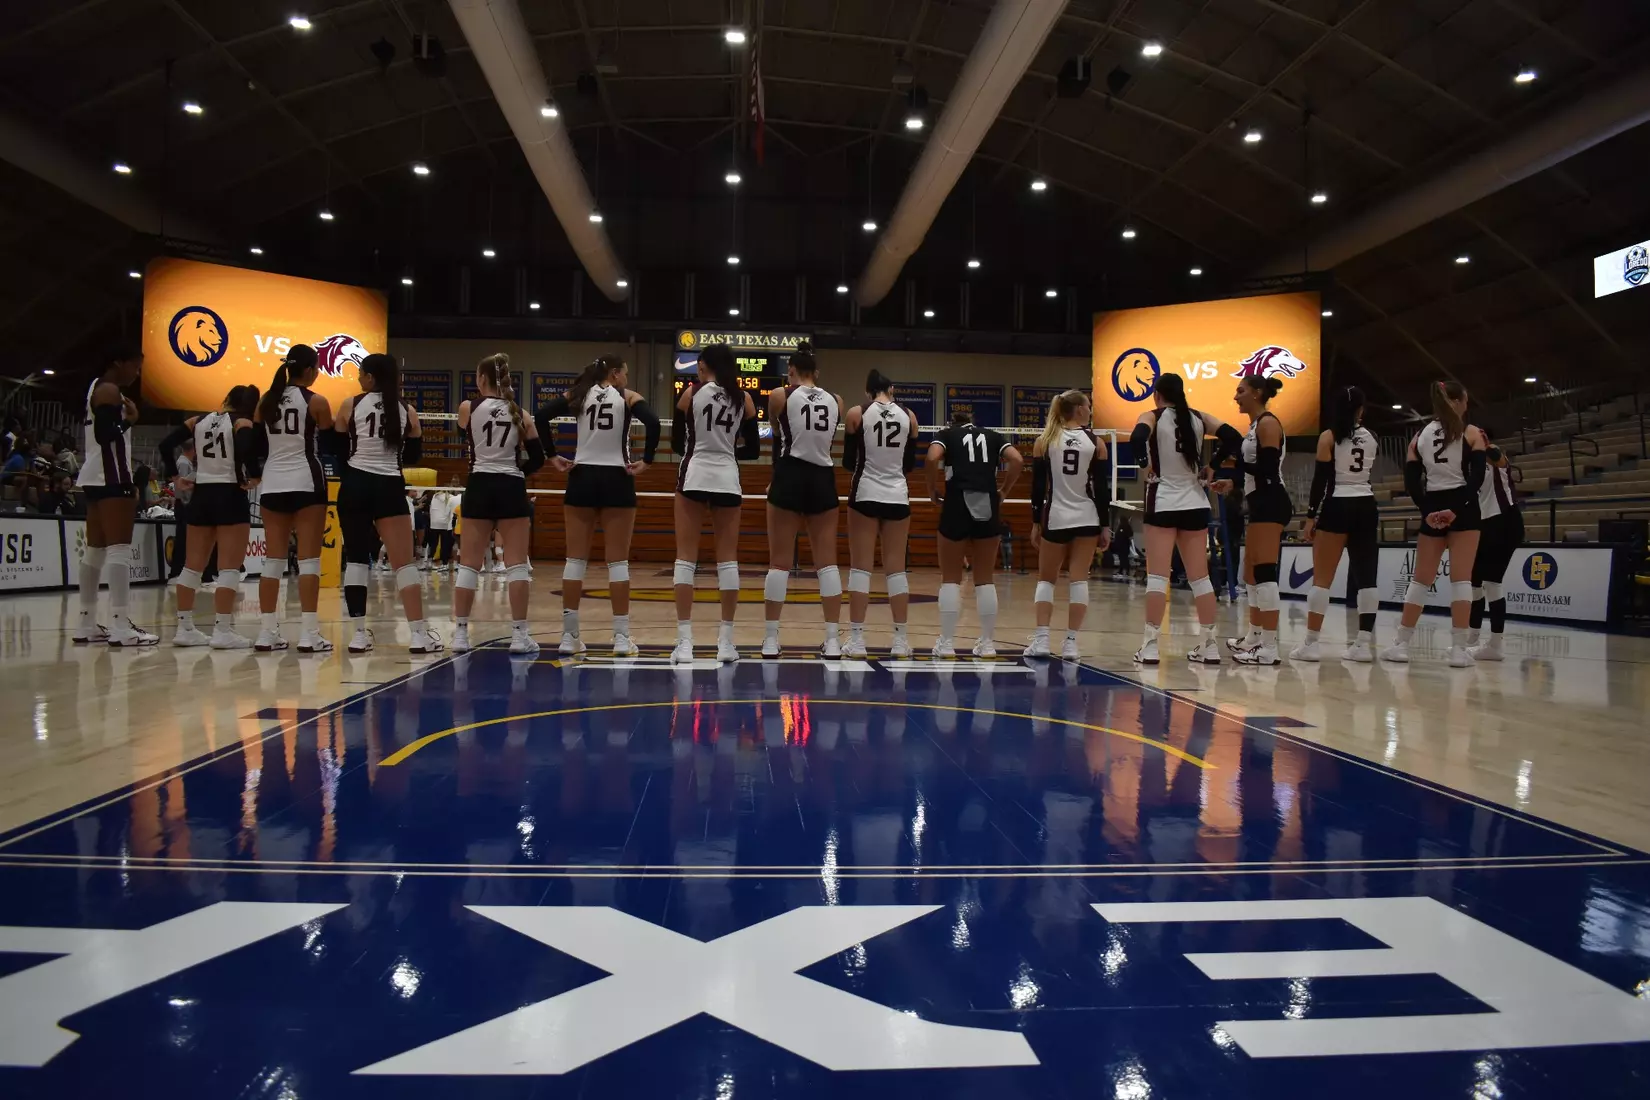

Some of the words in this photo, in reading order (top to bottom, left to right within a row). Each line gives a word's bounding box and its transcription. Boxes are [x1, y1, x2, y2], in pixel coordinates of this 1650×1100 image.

[254, 334, 291, 355] VS
[700, 333, 732, 344] EAST
[736, 335, 779, 346] TEXAS
[780, 336, 810, 347] A&M
[1183, 361, 1219, 380] VS
[586, 403, 615, 431] 15
[702, 403, 734, 433] 14
[757, 409, 764, 418] 2
[800, 403, 829, 432] 13
[202, 431, 228, 459] 21
[482, 420, 512, 448] 17
[873, 421, 901, 448] 12
[962, 433, 989, 463] 11
[1350, 448, 1366, 473] 3
[1433, 438, 1448, 464] 2
[1062, 449, 1080, 476] 9
[0, 533, 32, 564] SG
[1507, 591, 1526, 603] EAST
[1527, 593, 1552, 605] TEXAS
[1552, 596, 1572, 606] A&M
